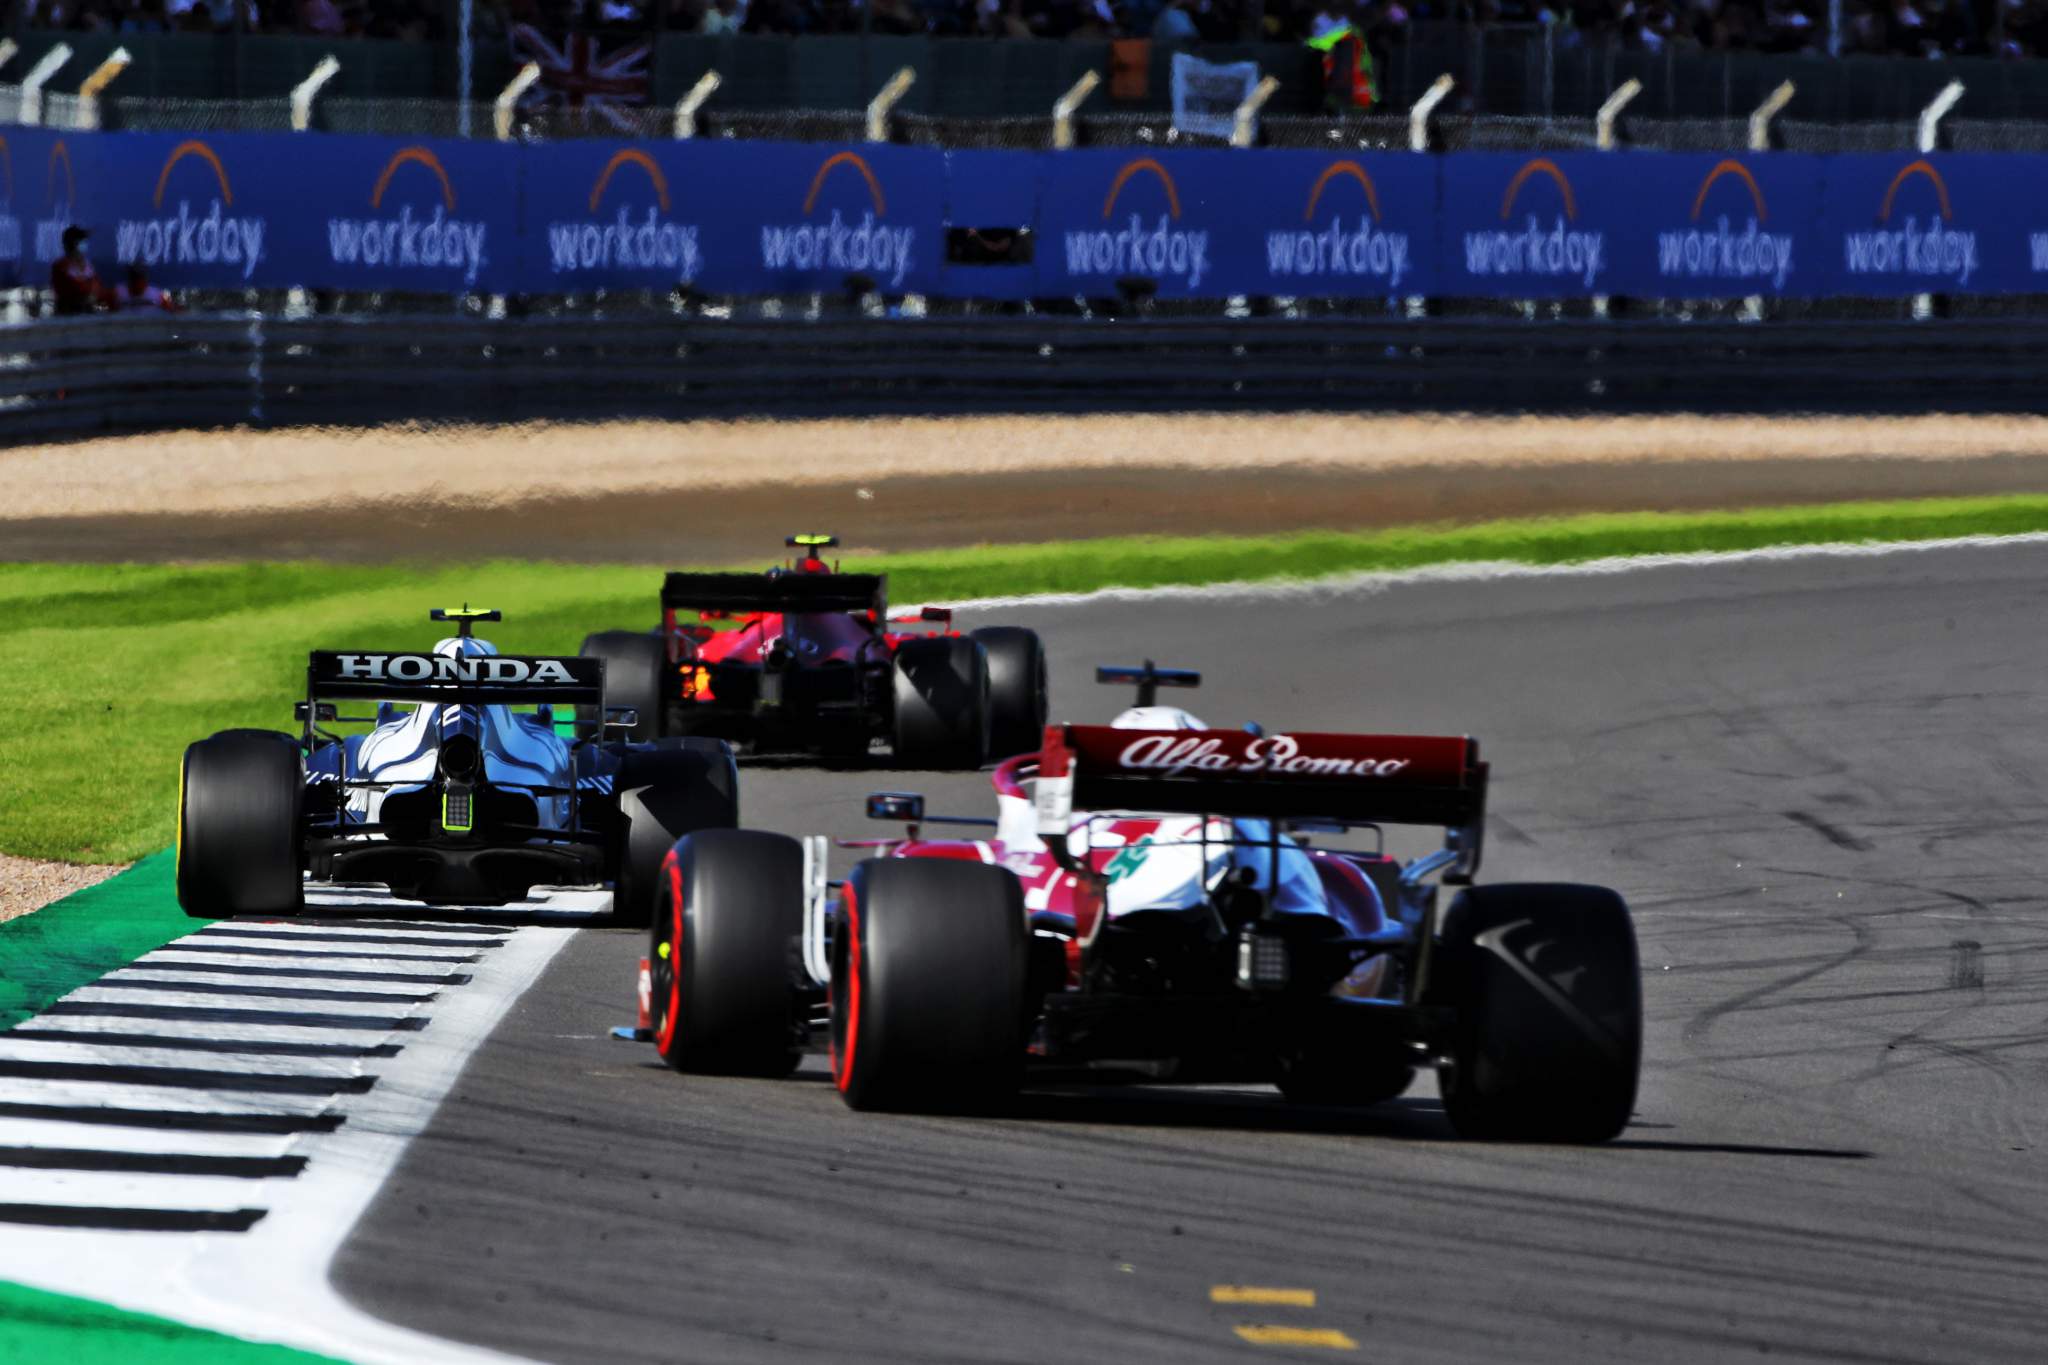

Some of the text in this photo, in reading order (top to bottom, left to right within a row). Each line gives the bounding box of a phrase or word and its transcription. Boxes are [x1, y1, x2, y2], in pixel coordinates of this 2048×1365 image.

[117, 202, 263, 277] workday
[329, 207, 484, 281] workday
[550, 207, 698, 282] workday
[761, 210, 912, 286] workday
[1066, 215, 1208, 288] workday
[1267, 217, 1408, 287] workday
[1465, 217, 1602, 287] workday
[1659, 219, 1792, 287] workday
[1847, 215, 1977, 284] workday
[336, 654, 579, 684] HONDA
[1118, 733, 1411, 778] Alfa Romeo
